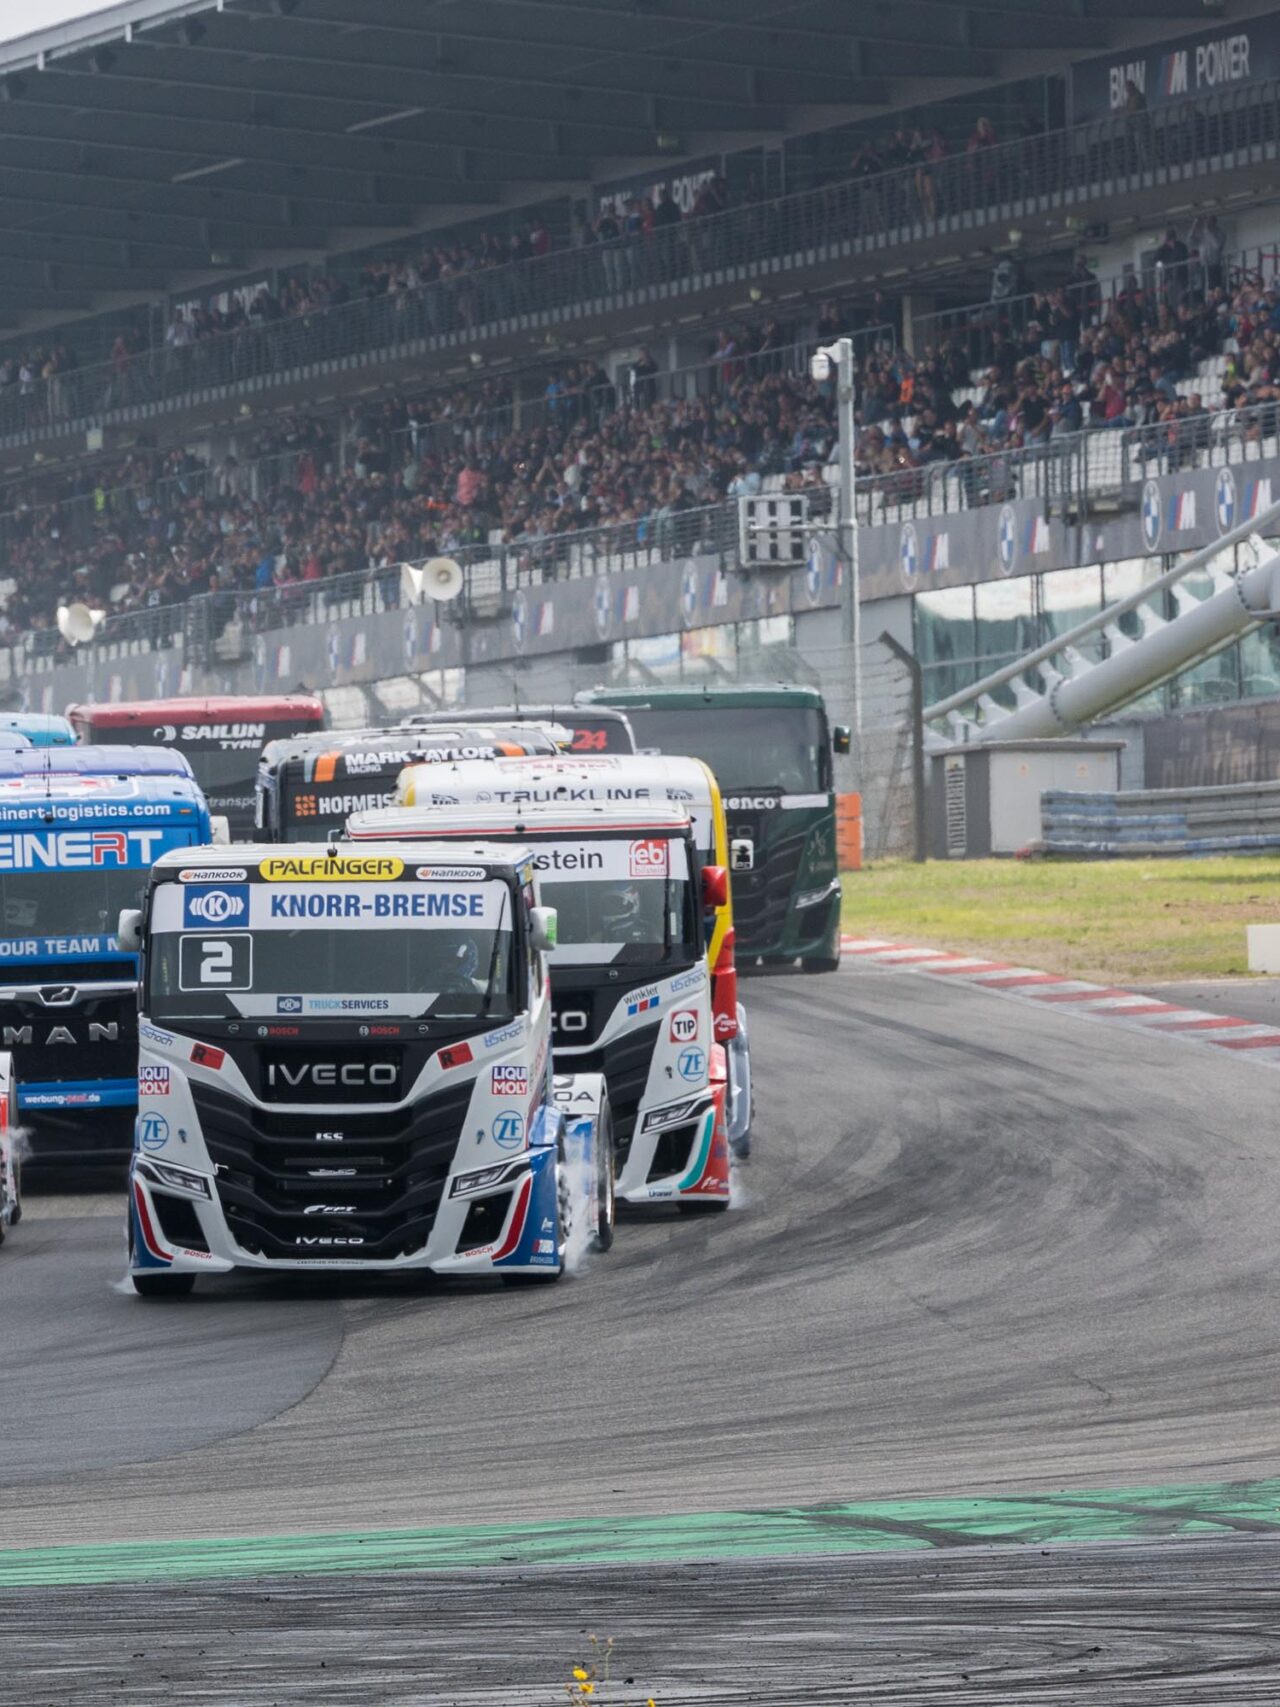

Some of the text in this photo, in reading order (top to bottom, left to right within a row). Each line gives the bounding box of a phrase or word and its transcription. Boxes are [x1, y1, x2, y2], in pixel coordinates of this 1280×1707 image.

[1196, 34, 1250, 88] POWER
[181, 724, 266, 740] SAILUN
[572, 729, 608, 750] 24
[219, 740, 263, 749] TYRE
[345, 746, 495, 767] MARK TAYLOR
[347, 764, 381, 774] RACING
[269, 857, 394, 877] PALFINGER
[271, 893, 484, 918] KNORR-BREMSE
[45, 939, 99, 954] TEAM
[200, 941, 233, 983] 2
[624, 986, 659, 1004] winkler
[308, 999, 389, 1010] TRUCKSERVICES
[2, 1022, 118, 1045] MAN
[269, 1027, 300, 1035] BOSCH
[371, 1026, 400, 1035] BOSCH
[674, 1019, 696, 1034] TIP
[269, 1064, 396, 1085] IVECO
[493, 1067, 527, 1080] LIQU
[493, 1081, 528, 1094] MOLY
[296, 1237, 364, 1245] IVECO
[184, 1250, 212, 1260] BOSCH
[464, 1245, 494, 1258] BOSCH
